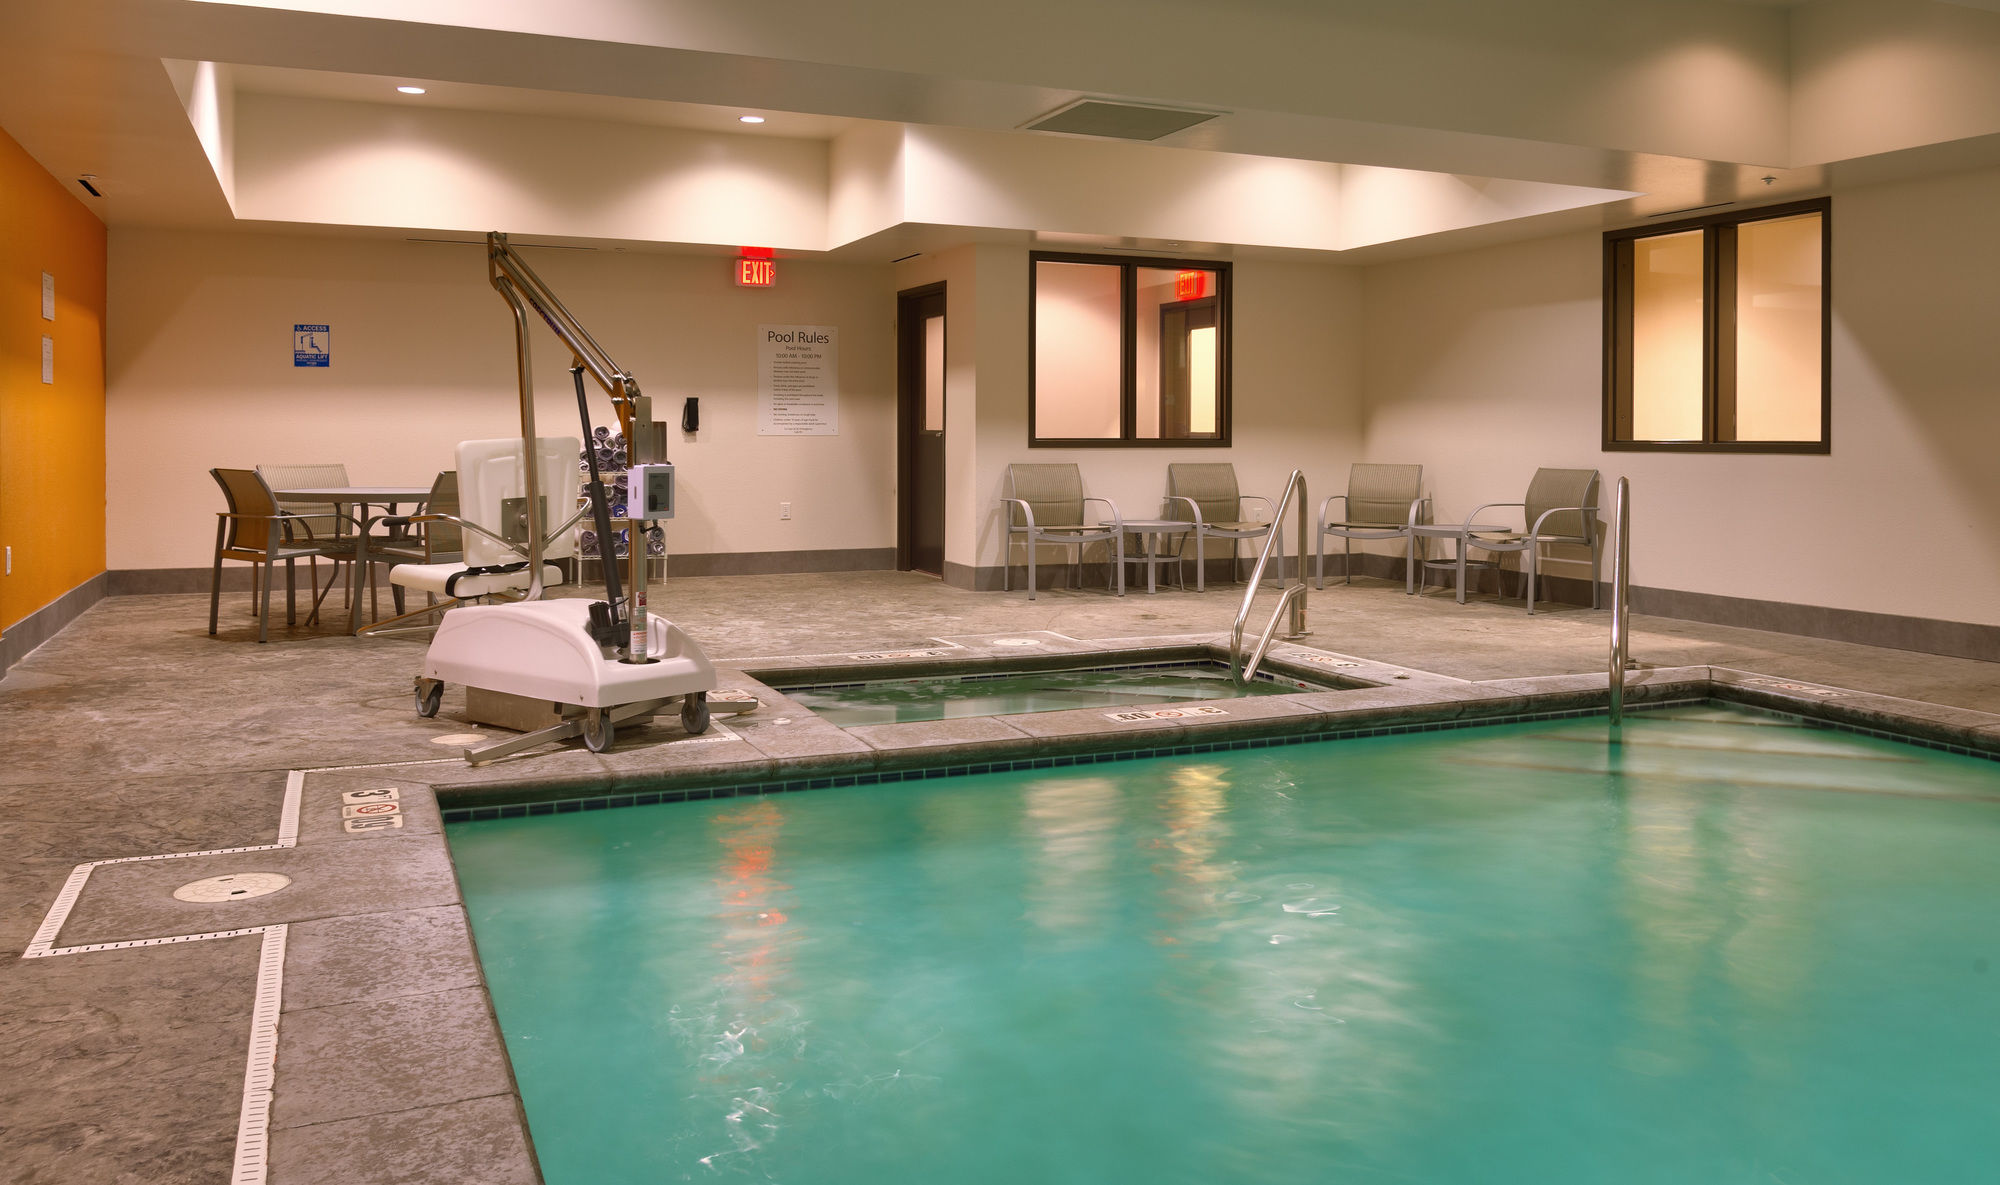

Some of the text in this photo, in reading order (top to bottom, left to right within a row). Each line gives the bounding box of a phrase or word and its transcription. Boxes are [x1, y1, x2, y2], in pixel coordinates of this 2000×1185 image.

[742, 261, 772, 285] EXIT
[1179, 273, 1195, 296] EXIT
[767, 330, 830, 344] Pool Rules
[350, 789, 391, 798] 3
